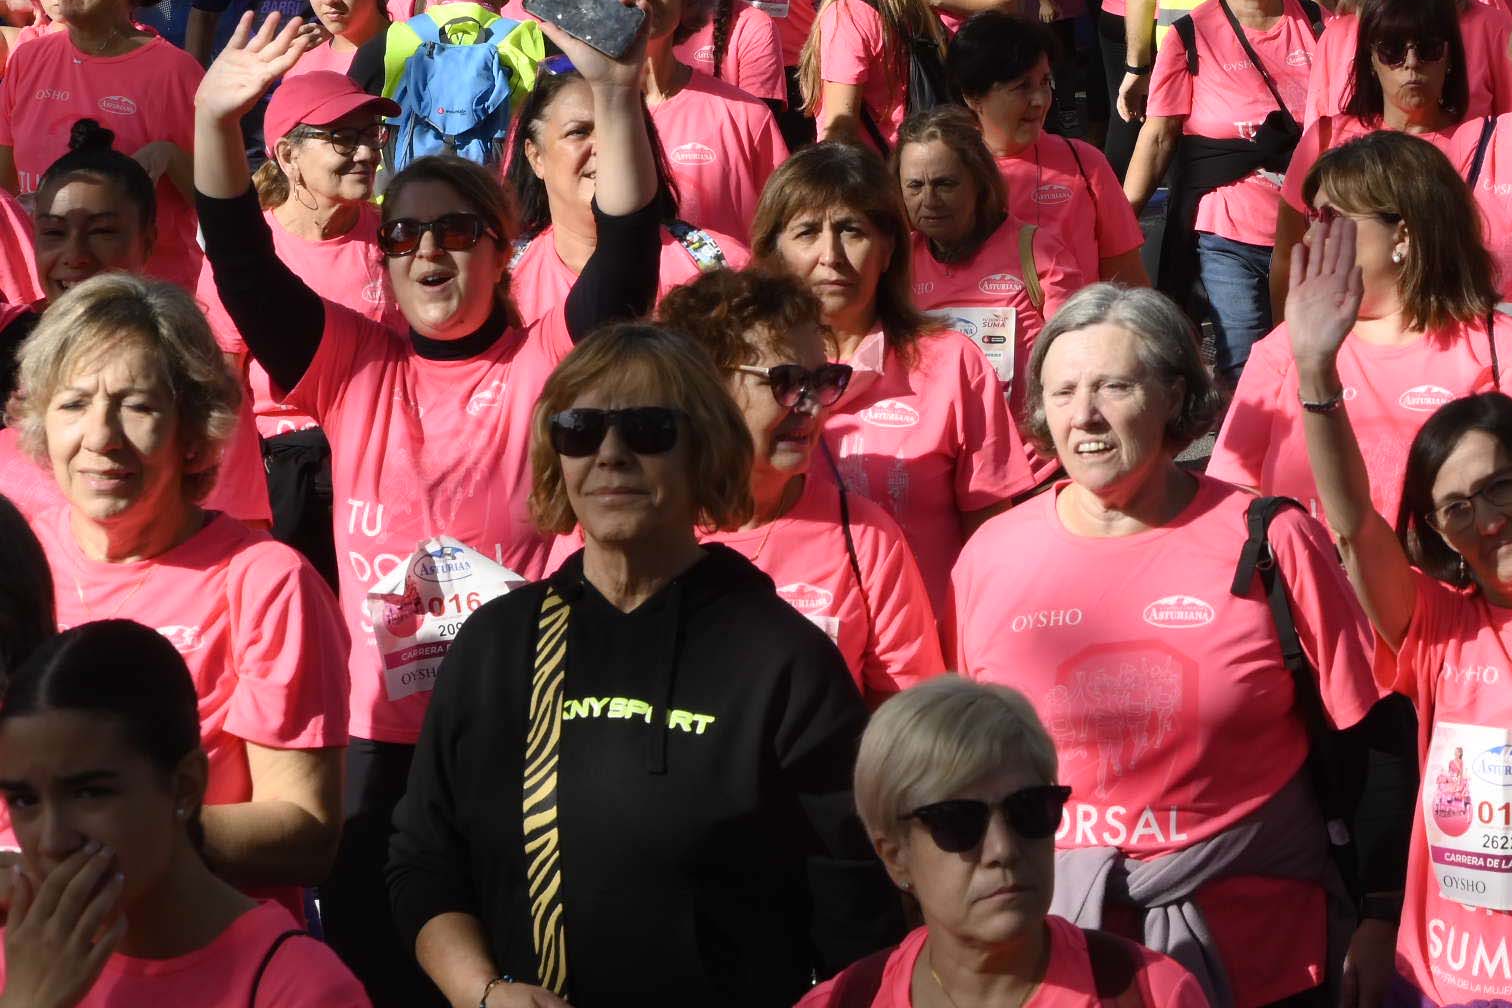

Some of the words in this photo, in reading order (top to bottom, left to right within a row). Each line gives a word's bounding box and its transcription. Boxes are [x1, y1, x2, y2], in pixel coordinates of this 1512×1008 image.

[347, 497, 384, 537] TU
[428, 592, 483, 617] 016
[1011, 608, 1083, 634] OYSHO
[1149, 609, 1212, 623] ASTURIANA
[401, 645, 443, 661] CARRERA
[1444, 852, 1485, 867] CARRERA
[1486, 858, 1499, 869] DE
[1443, 874, 1487, 895] OYSHO
